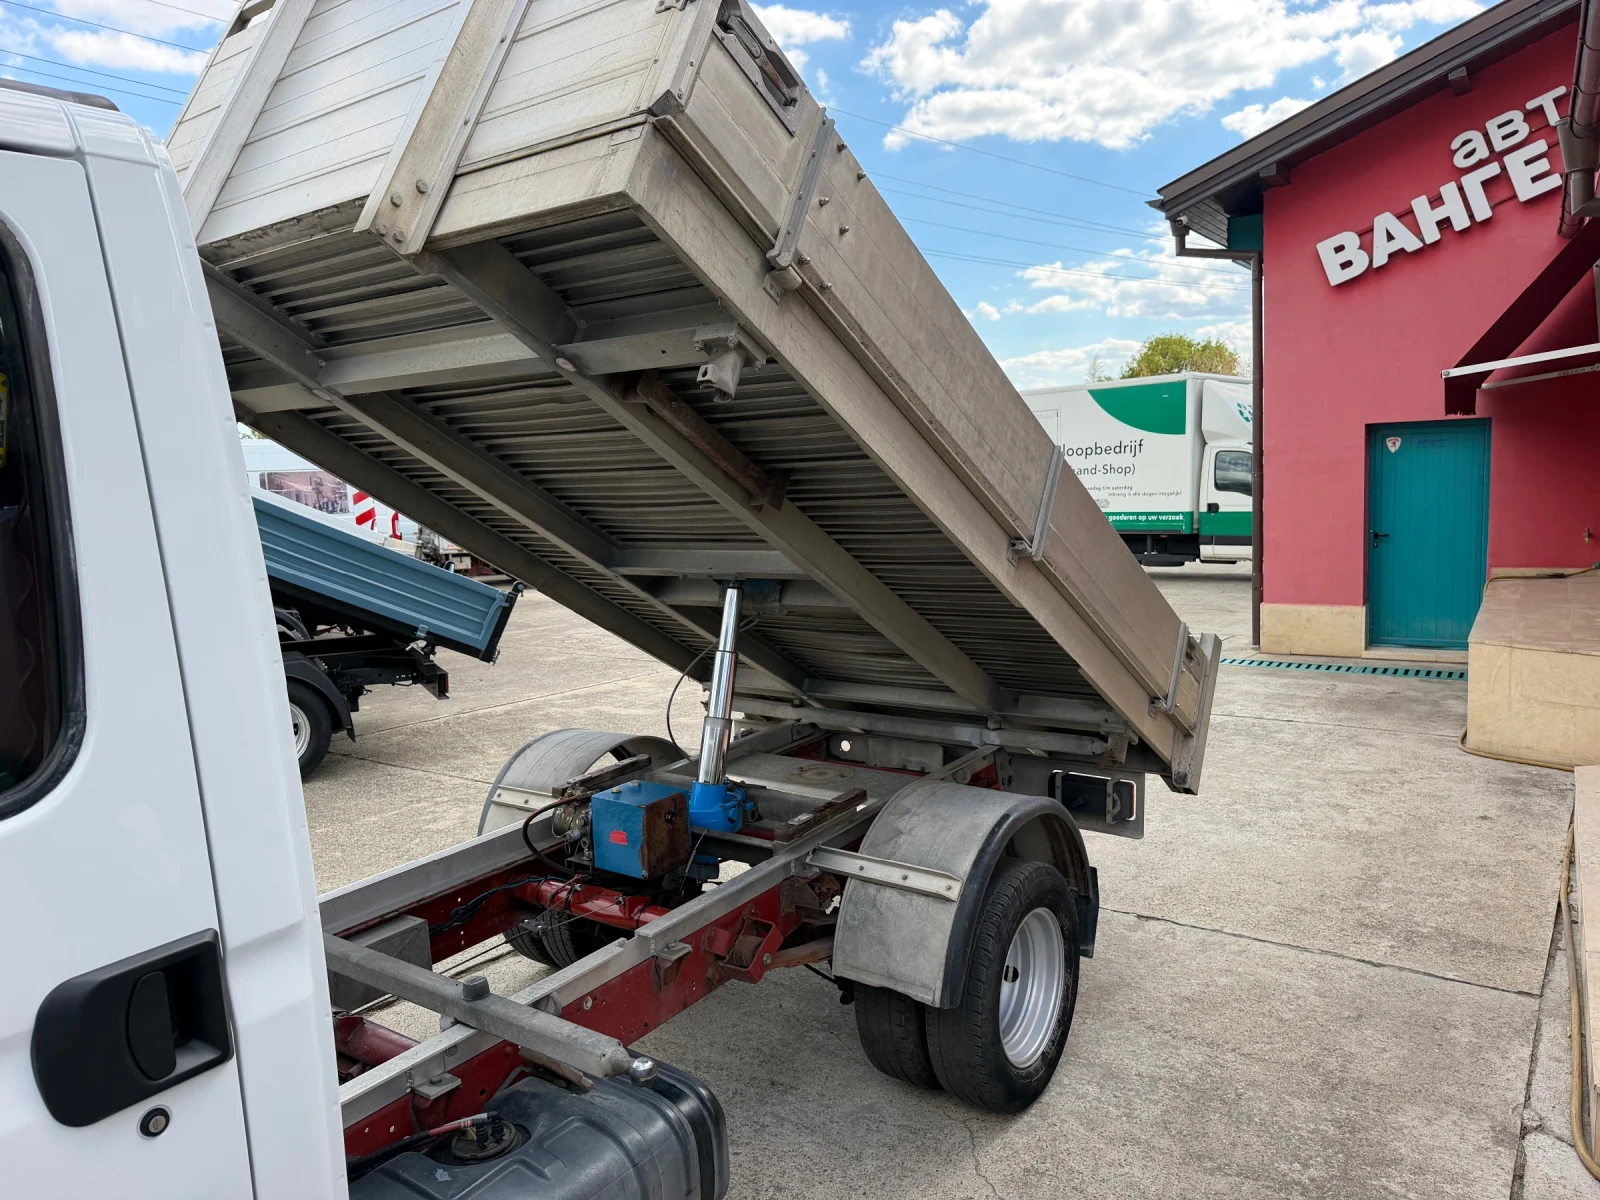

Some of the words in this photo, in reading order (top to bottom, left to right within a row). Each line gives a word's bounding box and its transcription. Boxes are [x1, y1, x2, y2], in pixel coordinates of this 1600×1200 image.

[1316, 138, 1563, 287] ВАНГЕ
[1073, 463, 1136, 477] and-Shop)
[1108, 513, 1137, 522] goederen
[1158, 513, 1184, 521] verzoek
